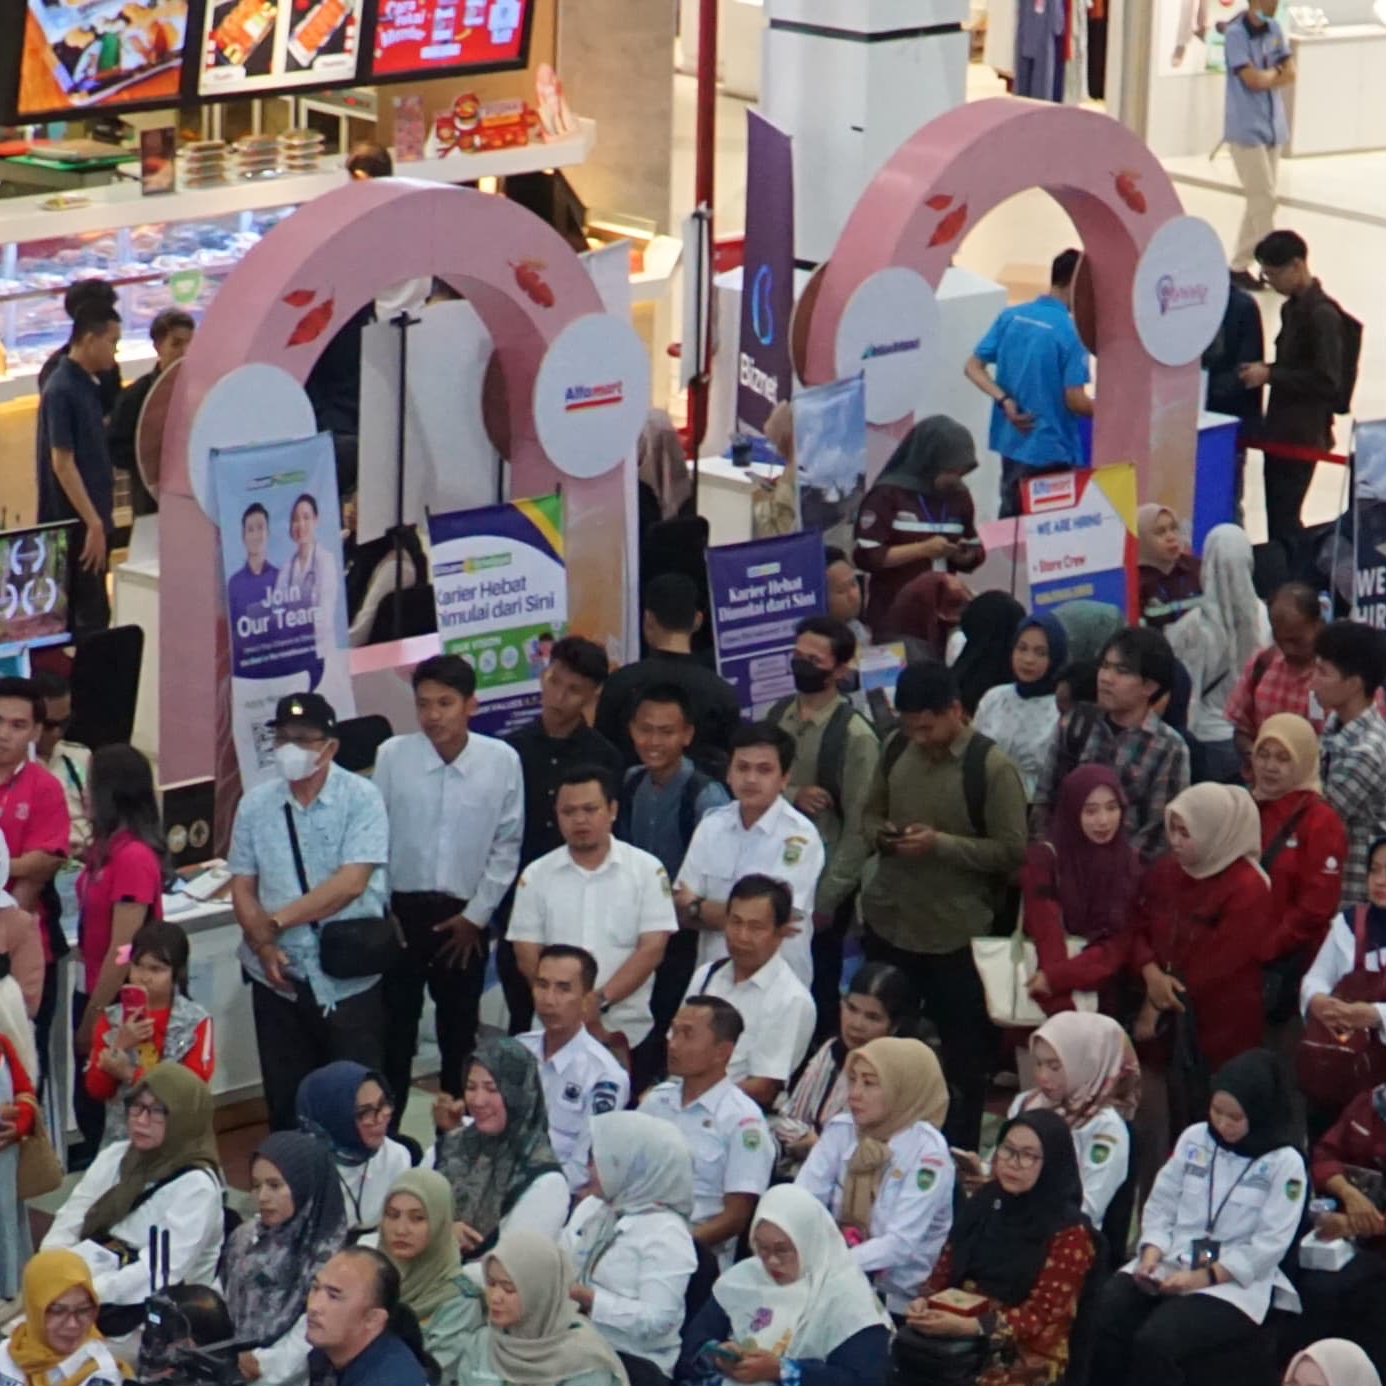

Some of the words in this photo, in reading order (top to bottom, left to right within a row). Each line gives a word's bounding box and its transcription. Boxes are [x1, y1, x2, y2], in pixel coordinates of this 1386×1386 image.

[740, 351, 779, 406] Biznet
[480, 576, 527, 599] Hebat
[1357, 566, 1386, 598] WE
[261, 585, 301, 608] Join
[491, 599, 522, 619] dari
[525, 592, 555, 613] Sini
[237, 614, 270, 638] Our
